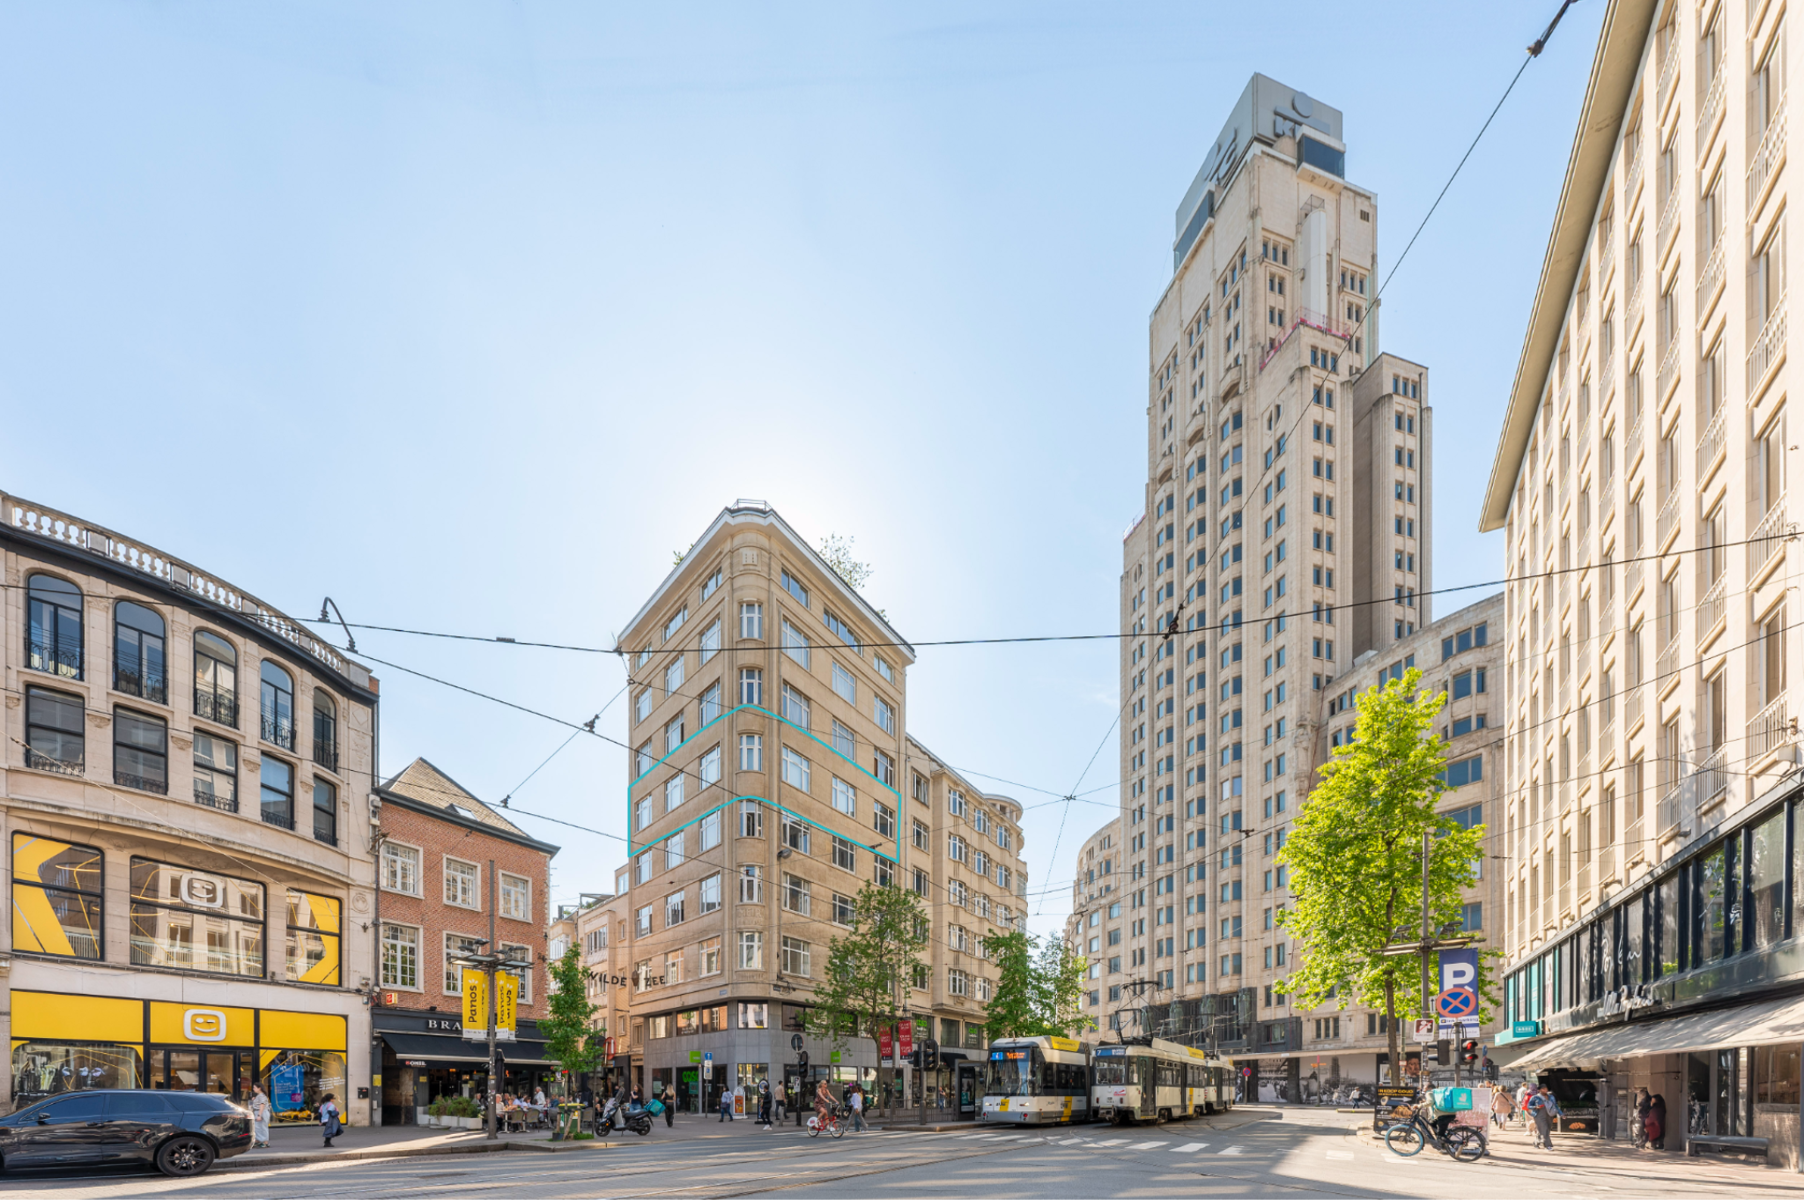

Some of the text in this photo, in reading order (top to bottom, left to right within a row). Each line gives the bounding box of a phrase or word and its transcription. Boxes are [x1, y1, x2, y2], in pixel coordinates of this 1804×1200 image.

[588, 971, 666, 989] WILDE ZEE
[468, 985, 477, 1023] Panos
